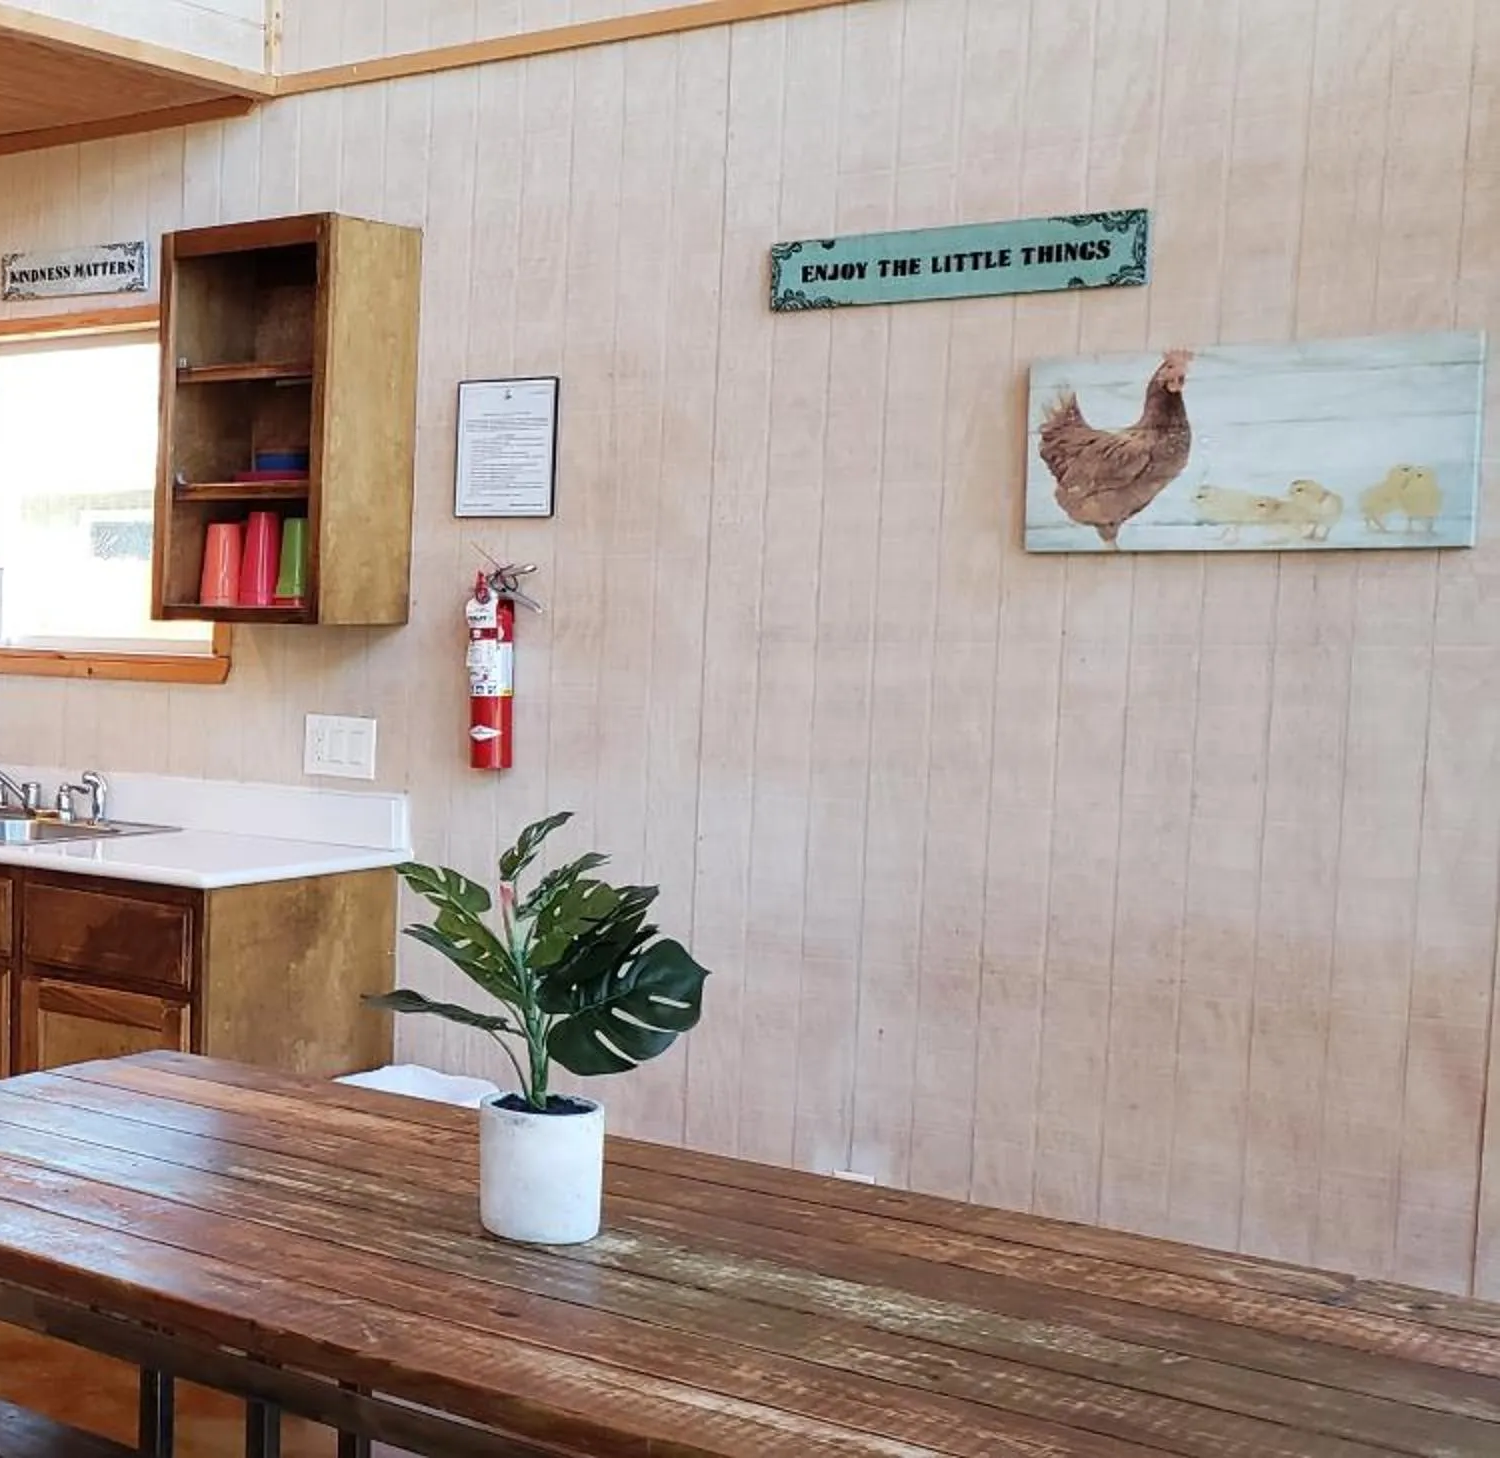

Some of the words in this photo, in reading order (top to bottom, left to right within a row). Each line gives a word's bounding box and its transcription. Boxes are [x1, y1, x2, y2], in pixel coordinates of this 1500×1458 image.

[9, 265, 71, 284] KINDNESS
[73, 259, 135, 279] MATTERS
[801, 261, 868, 283] ENJOY
[878, 257, 921, 278] THE
[931, 249, 1012, 274] LITTLE
[1021, 239, 1111, 266] THINGS
